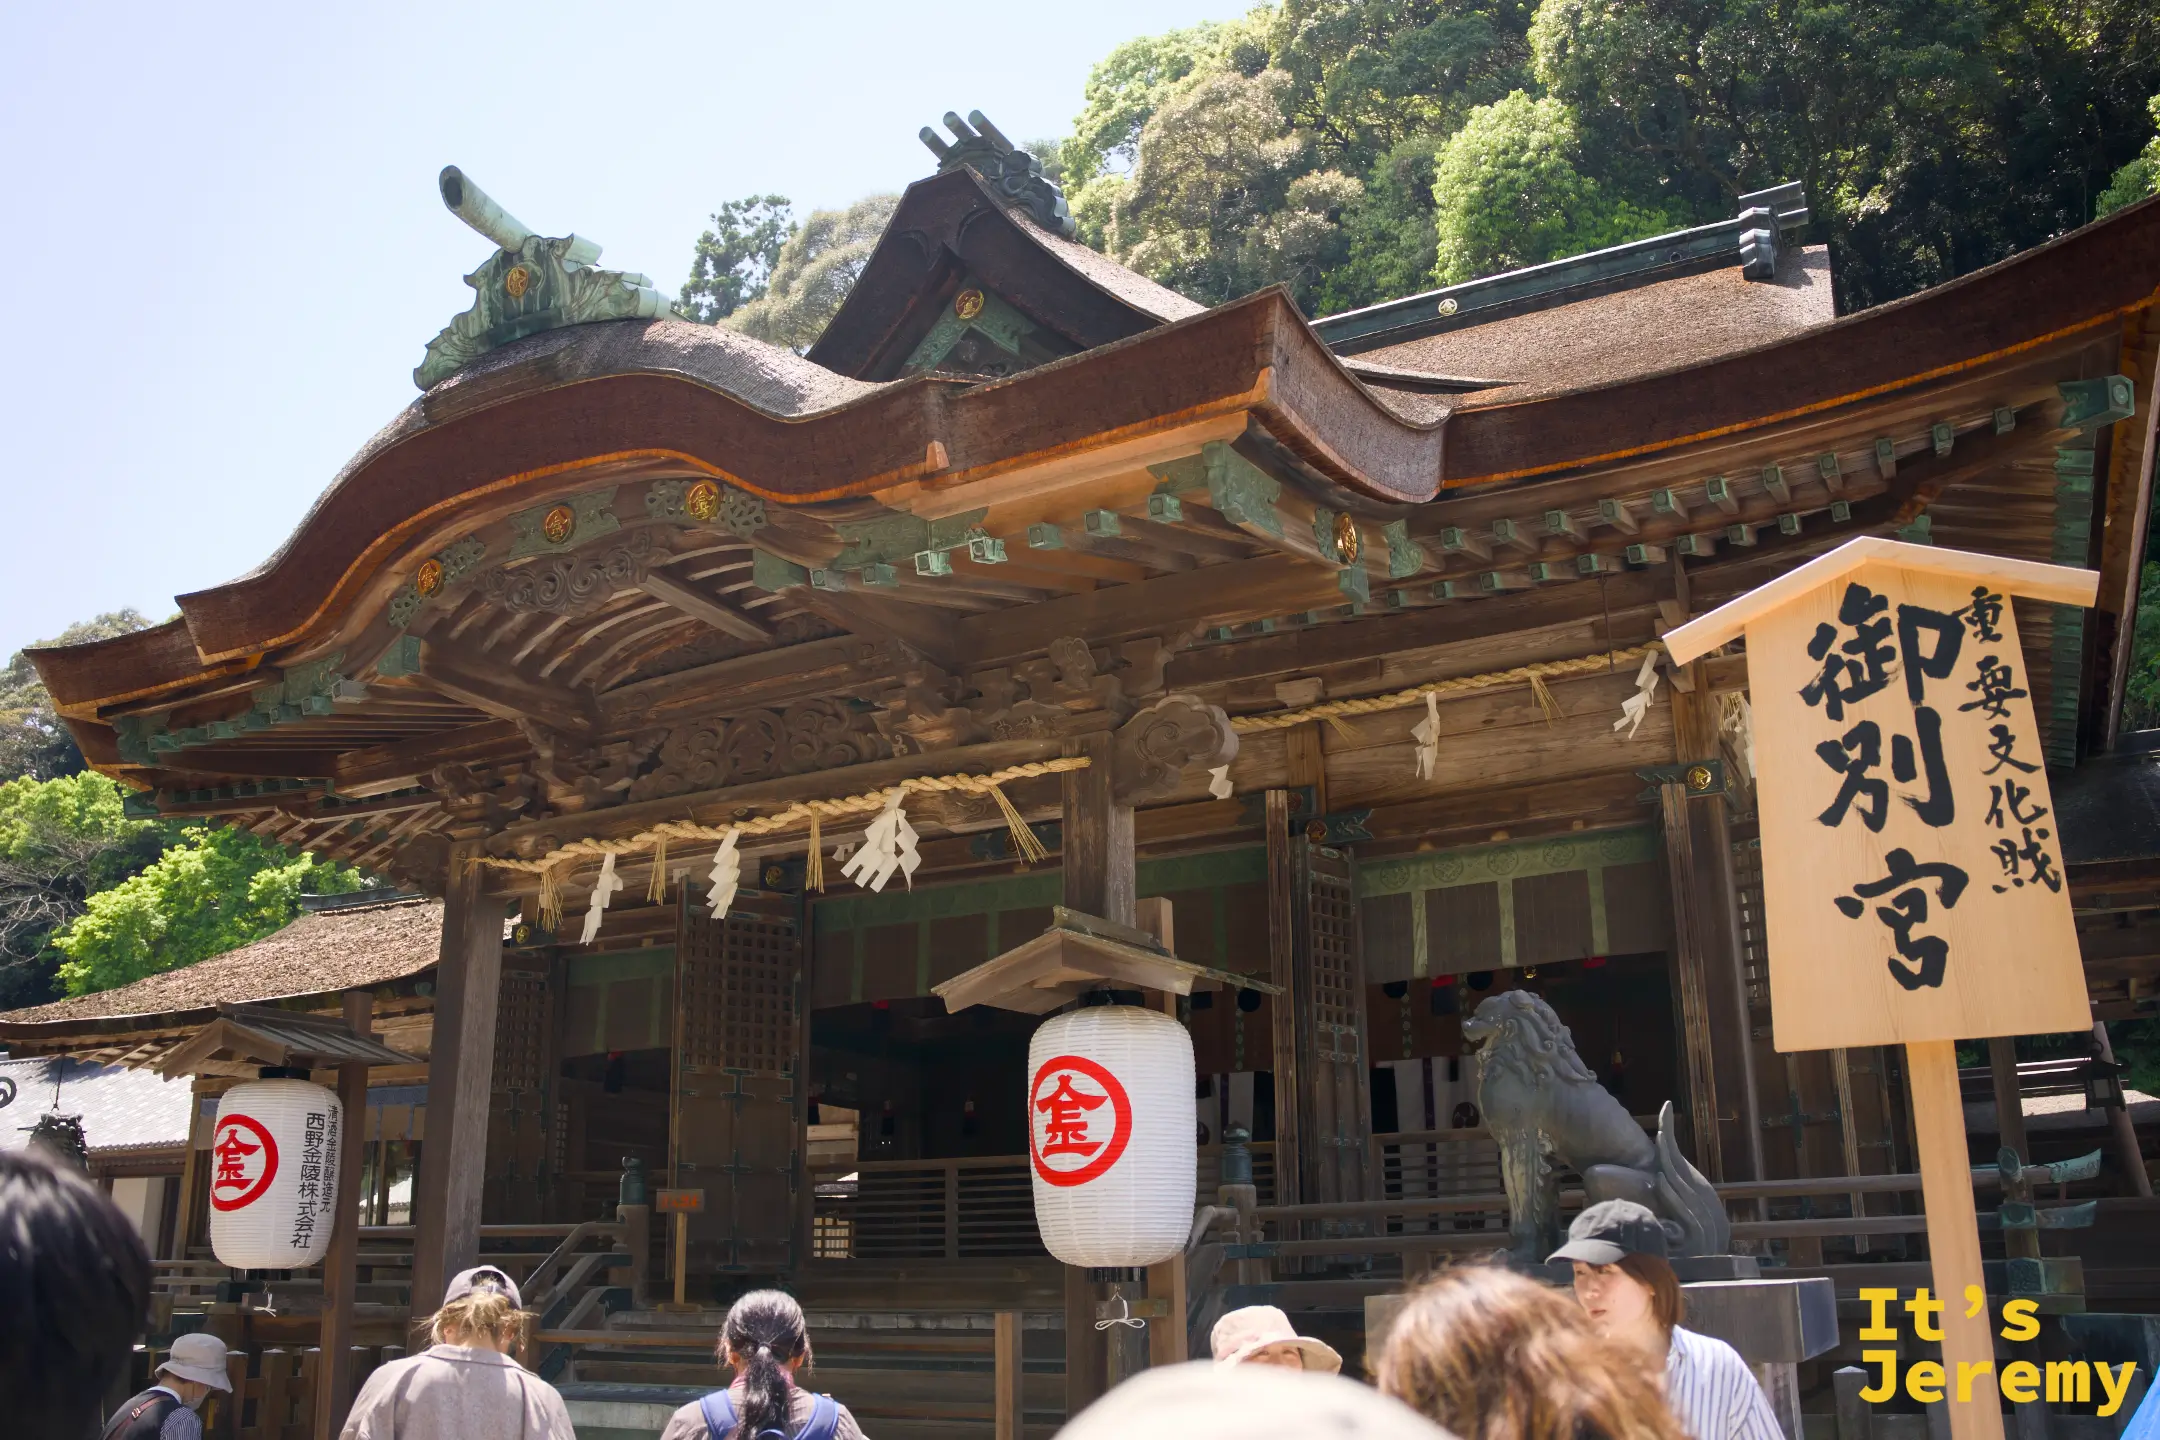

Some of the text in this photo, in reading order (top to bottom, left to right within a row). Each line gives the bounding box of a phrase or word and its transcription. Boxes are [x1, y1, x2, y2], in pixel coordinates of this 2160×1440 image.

[1800, 582, 1970, 991] 御別宮
[291, 1112, 325, 1249] 西野金陵株式会社
